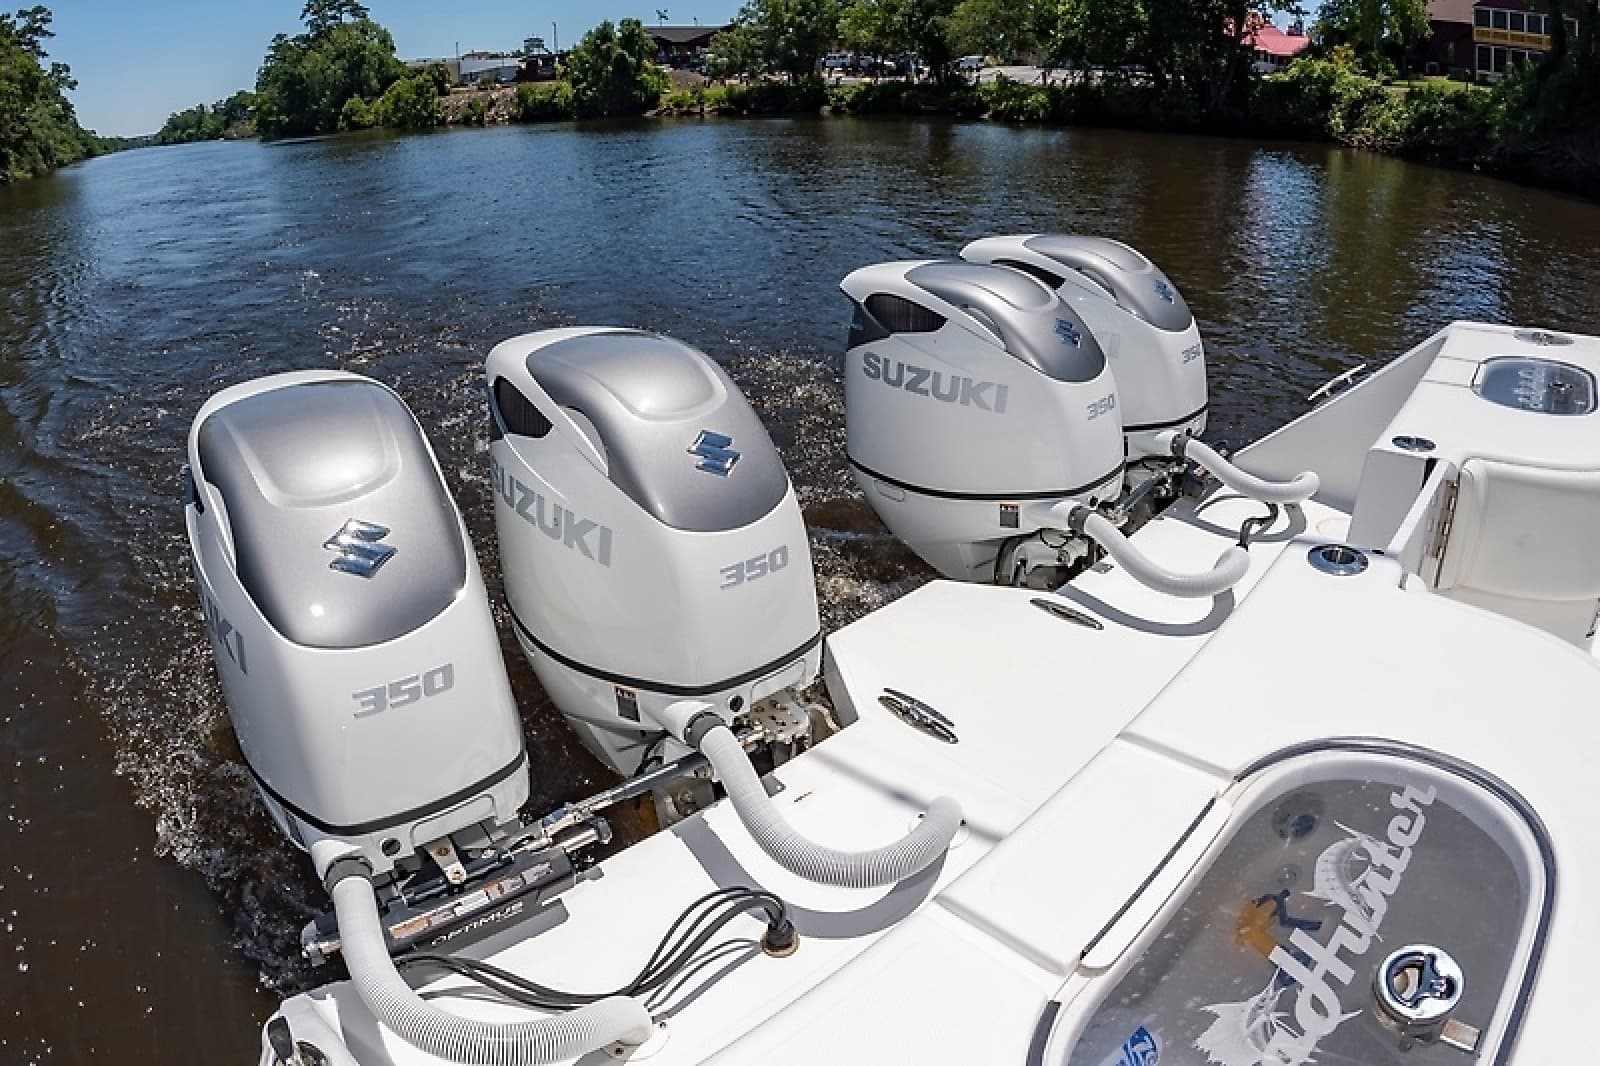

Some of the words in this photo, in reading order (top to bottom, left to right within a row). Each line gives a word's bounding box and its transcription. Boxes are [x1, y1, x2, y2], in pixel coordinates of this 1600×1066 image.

[863, 351, 1009, 414] SUZUKI
[1087, 393, 1115, 421] 350
[491, 456, 613, 568] SUZUKI
[720, 544, 789, 590] 350
[352, 663, 455, 719] 350
